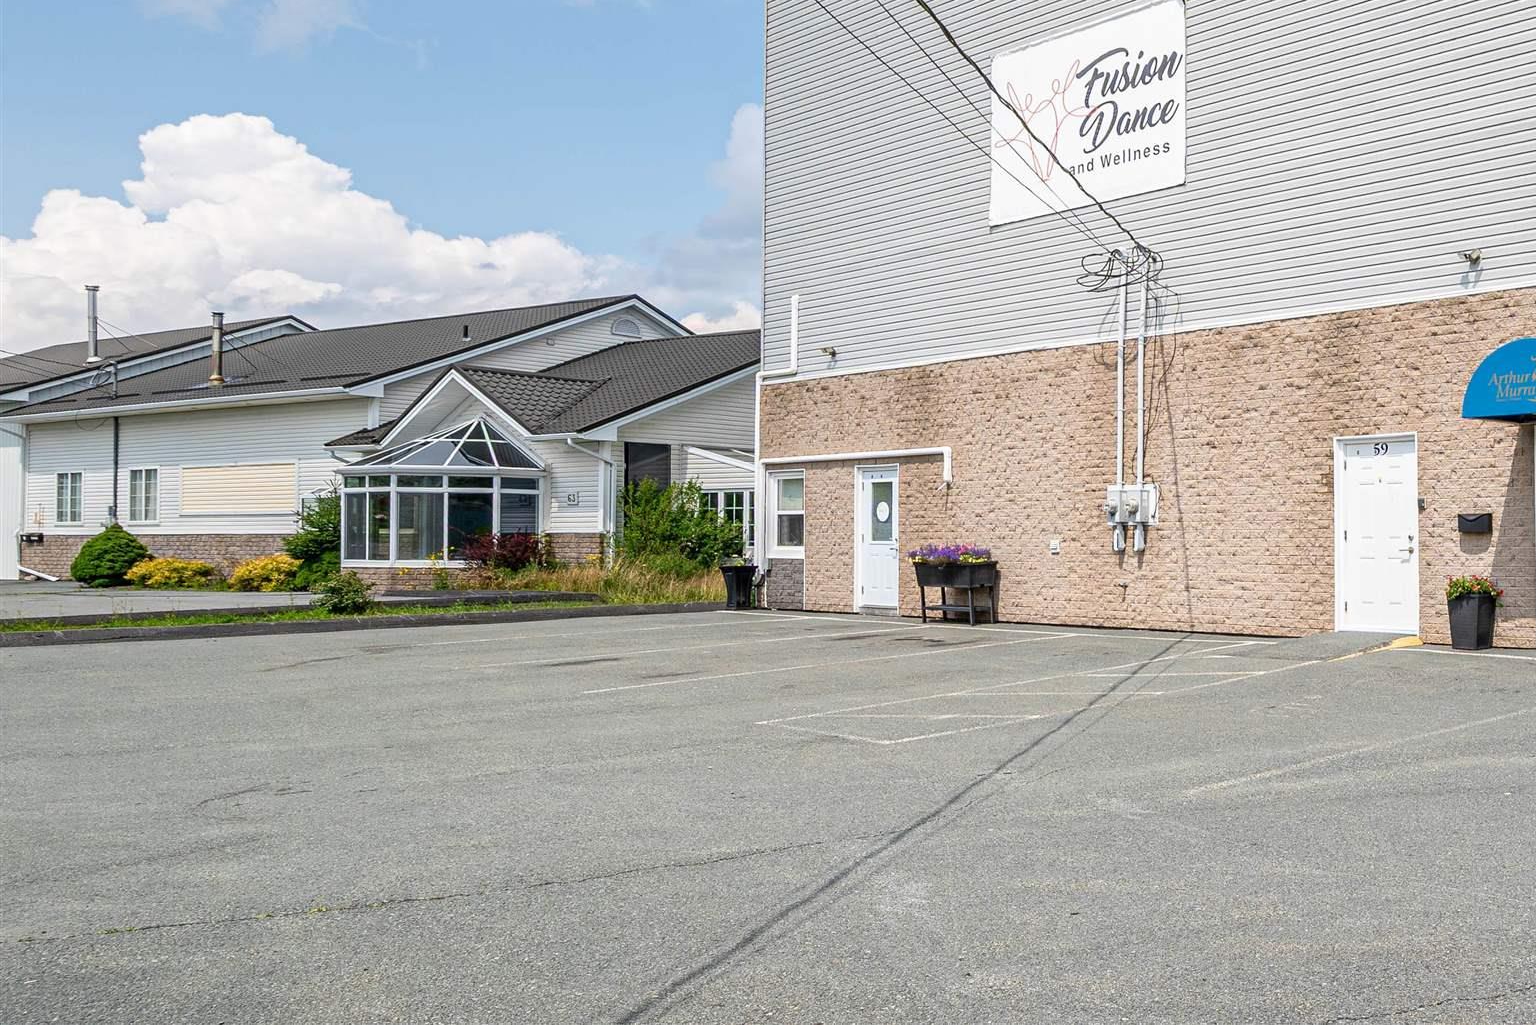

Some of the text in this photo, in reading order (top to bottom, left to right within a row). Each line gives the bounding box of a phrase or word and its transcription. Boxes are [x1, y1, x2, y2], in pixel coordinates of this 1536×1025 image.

[1075, 47, 1183, 109] Fusion
[1079, 98, 1180, 154] Dance
[1069, 141, 1171, 176] and Wellness
[1488, 370, 1531, 386] Arthur
[1373, 441, 1389, 456] 59
